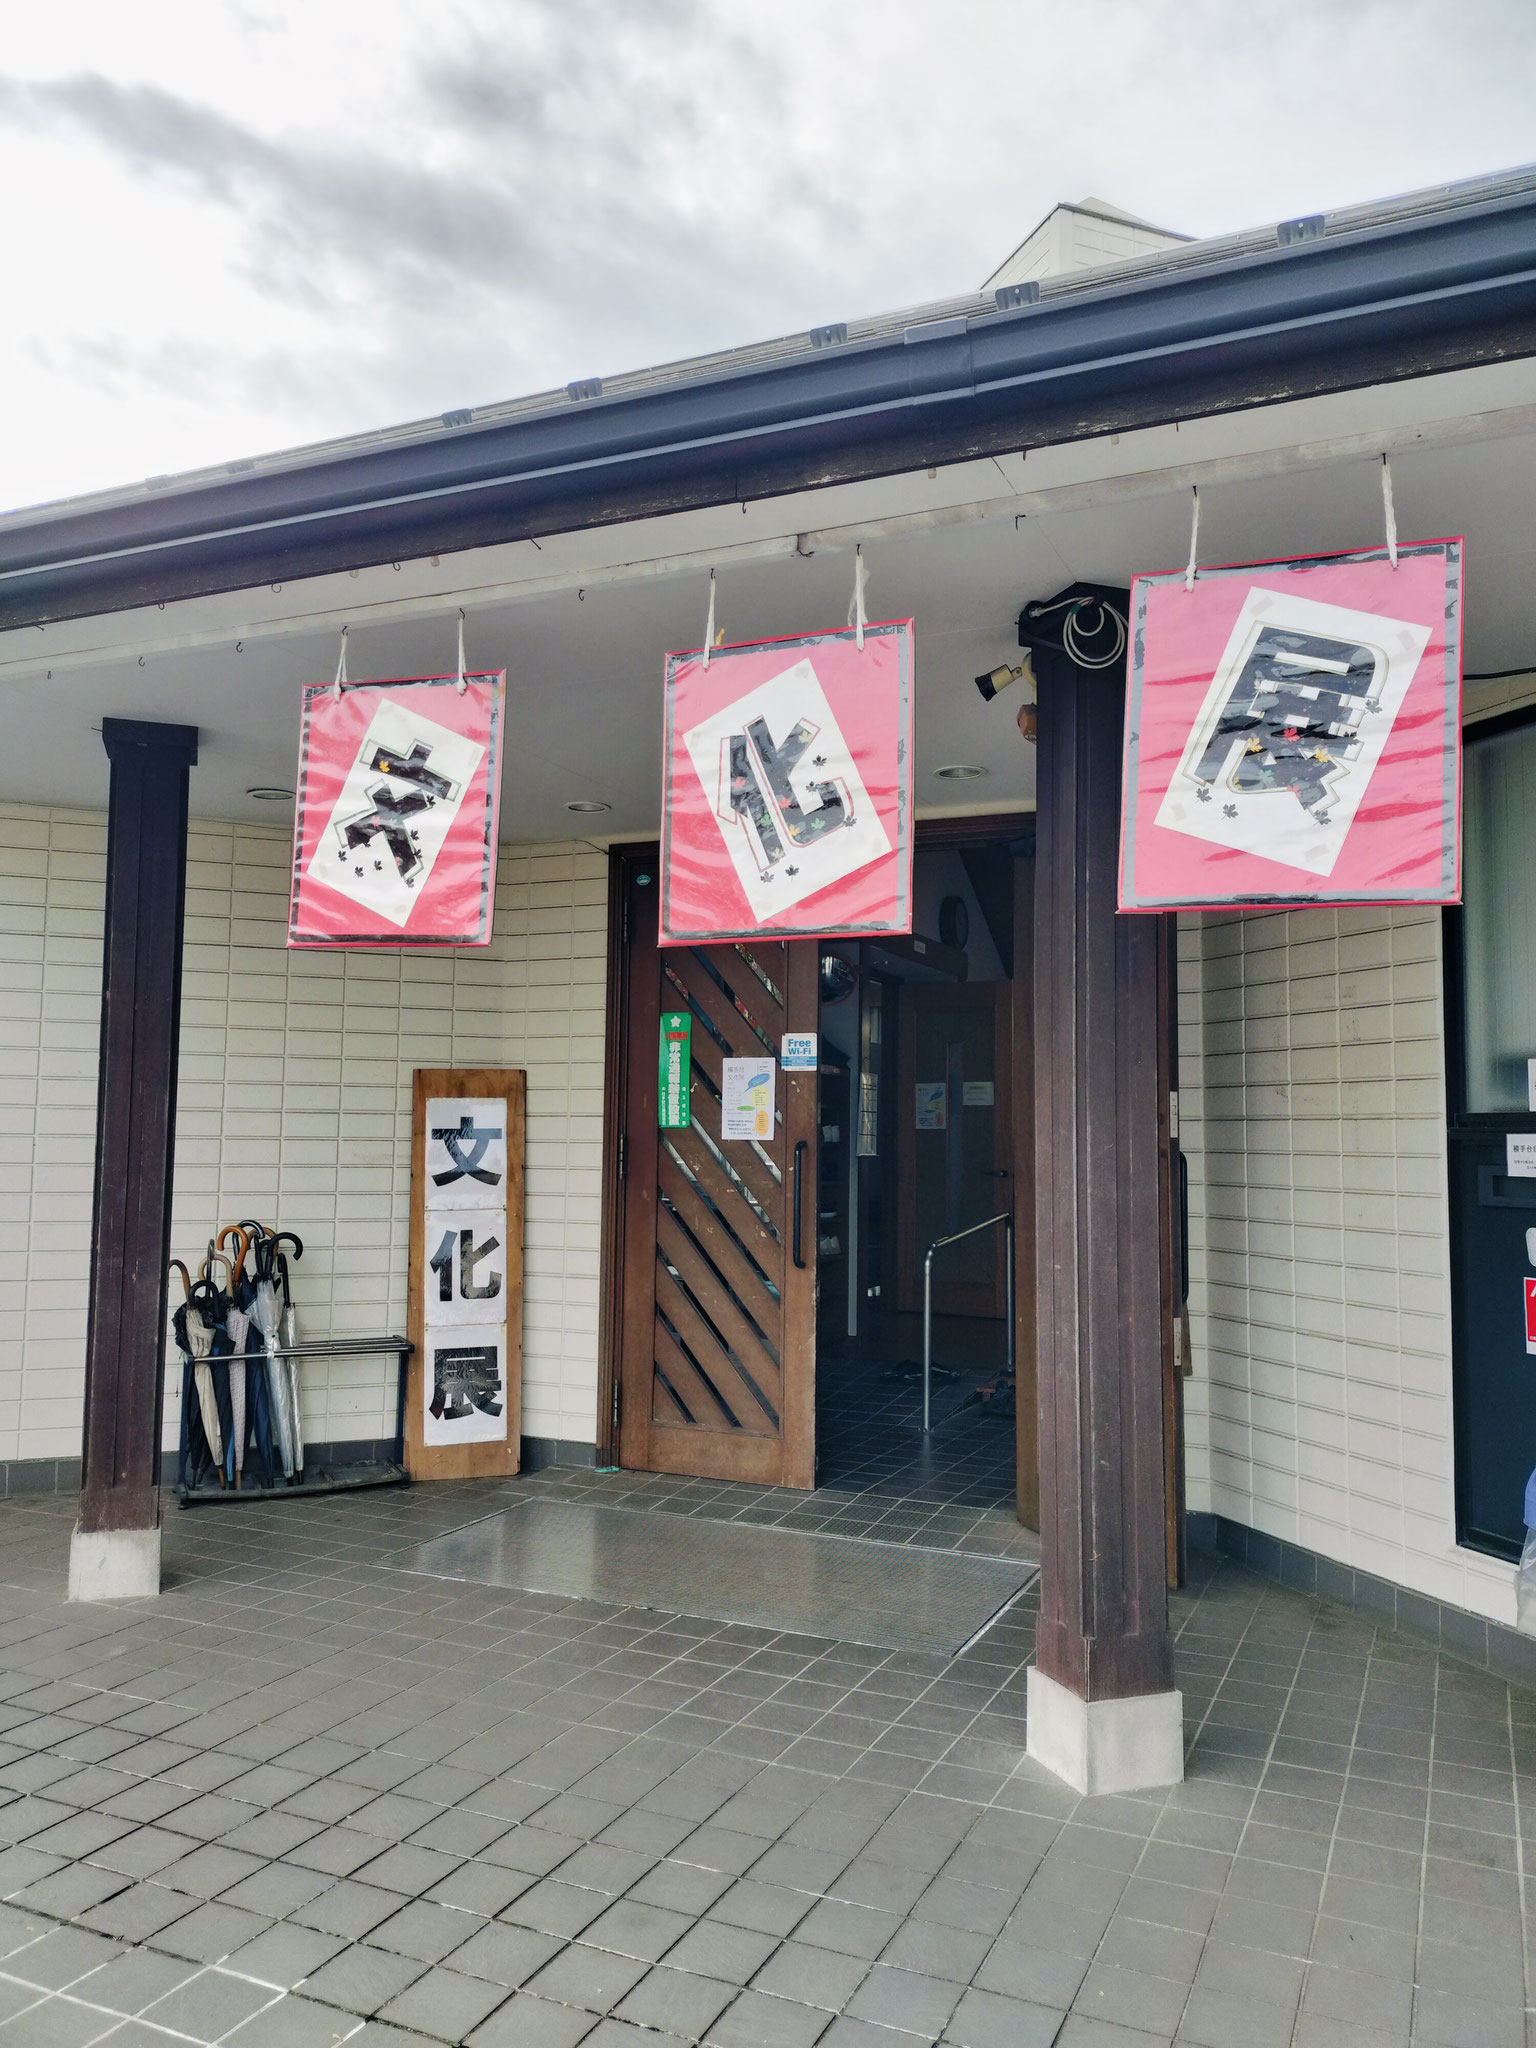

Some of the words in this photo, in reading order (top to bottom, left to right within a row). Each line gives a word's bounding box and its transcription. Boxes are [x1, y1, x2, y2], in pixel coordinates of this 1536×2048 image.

[787, 1038, 812, 1048] Free
[787, 1047, 812, 1056] Wi-Fi
[429, 1116, 504, 1421] 文化展
